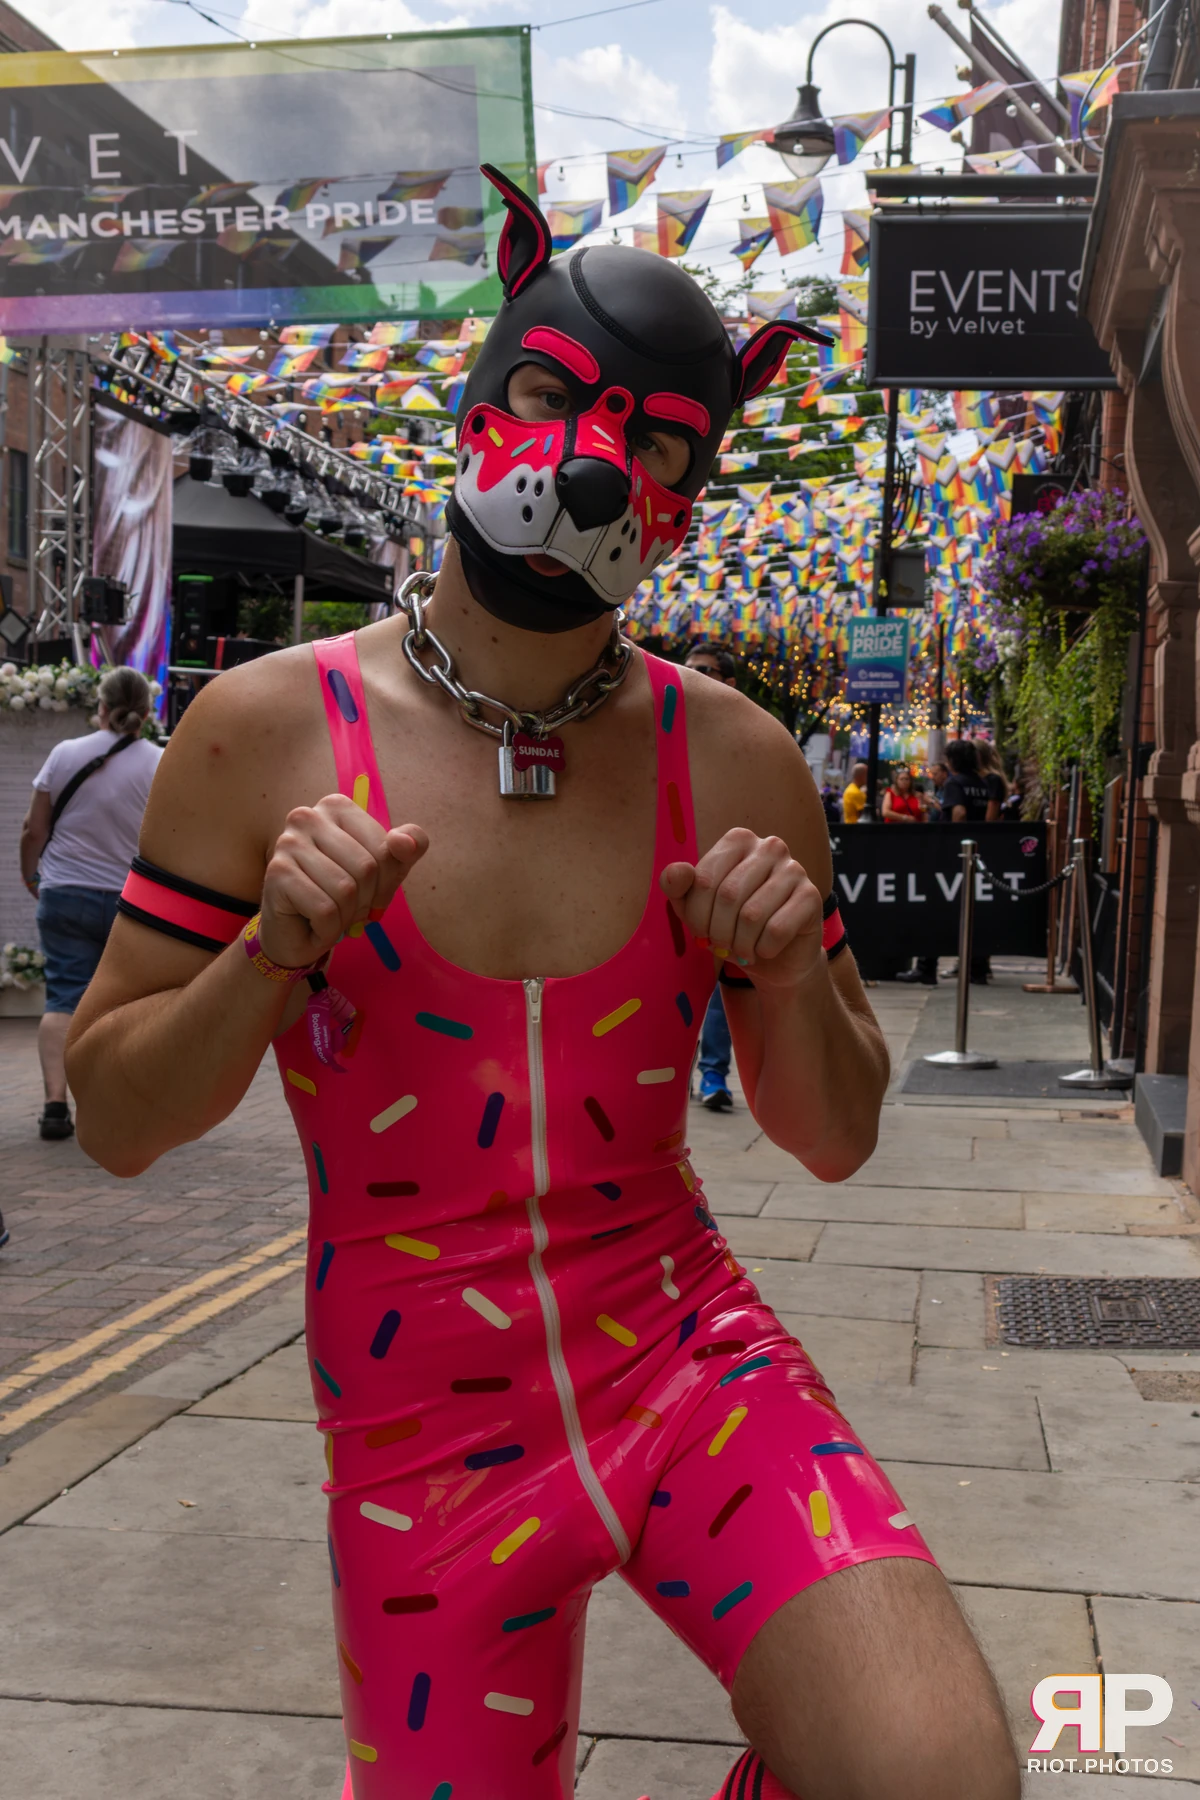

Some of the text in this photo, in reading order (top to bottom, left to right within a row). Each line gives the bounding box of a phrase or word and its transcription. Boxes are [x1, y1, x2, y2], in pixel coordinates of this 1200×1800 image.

[0, 198, 436, 241] MANCHESTER PRIDE
[910, 316, 1025, 339] by Velvet
[853, 622, 904, 638] HAPPY
[852, 635, 904, 653] PRIDE
[518, 745, 560, 758] SUNDAE
[837, 871, 1026, 903] VELVET
[311, 1013, 329, 1064] Booking.com
